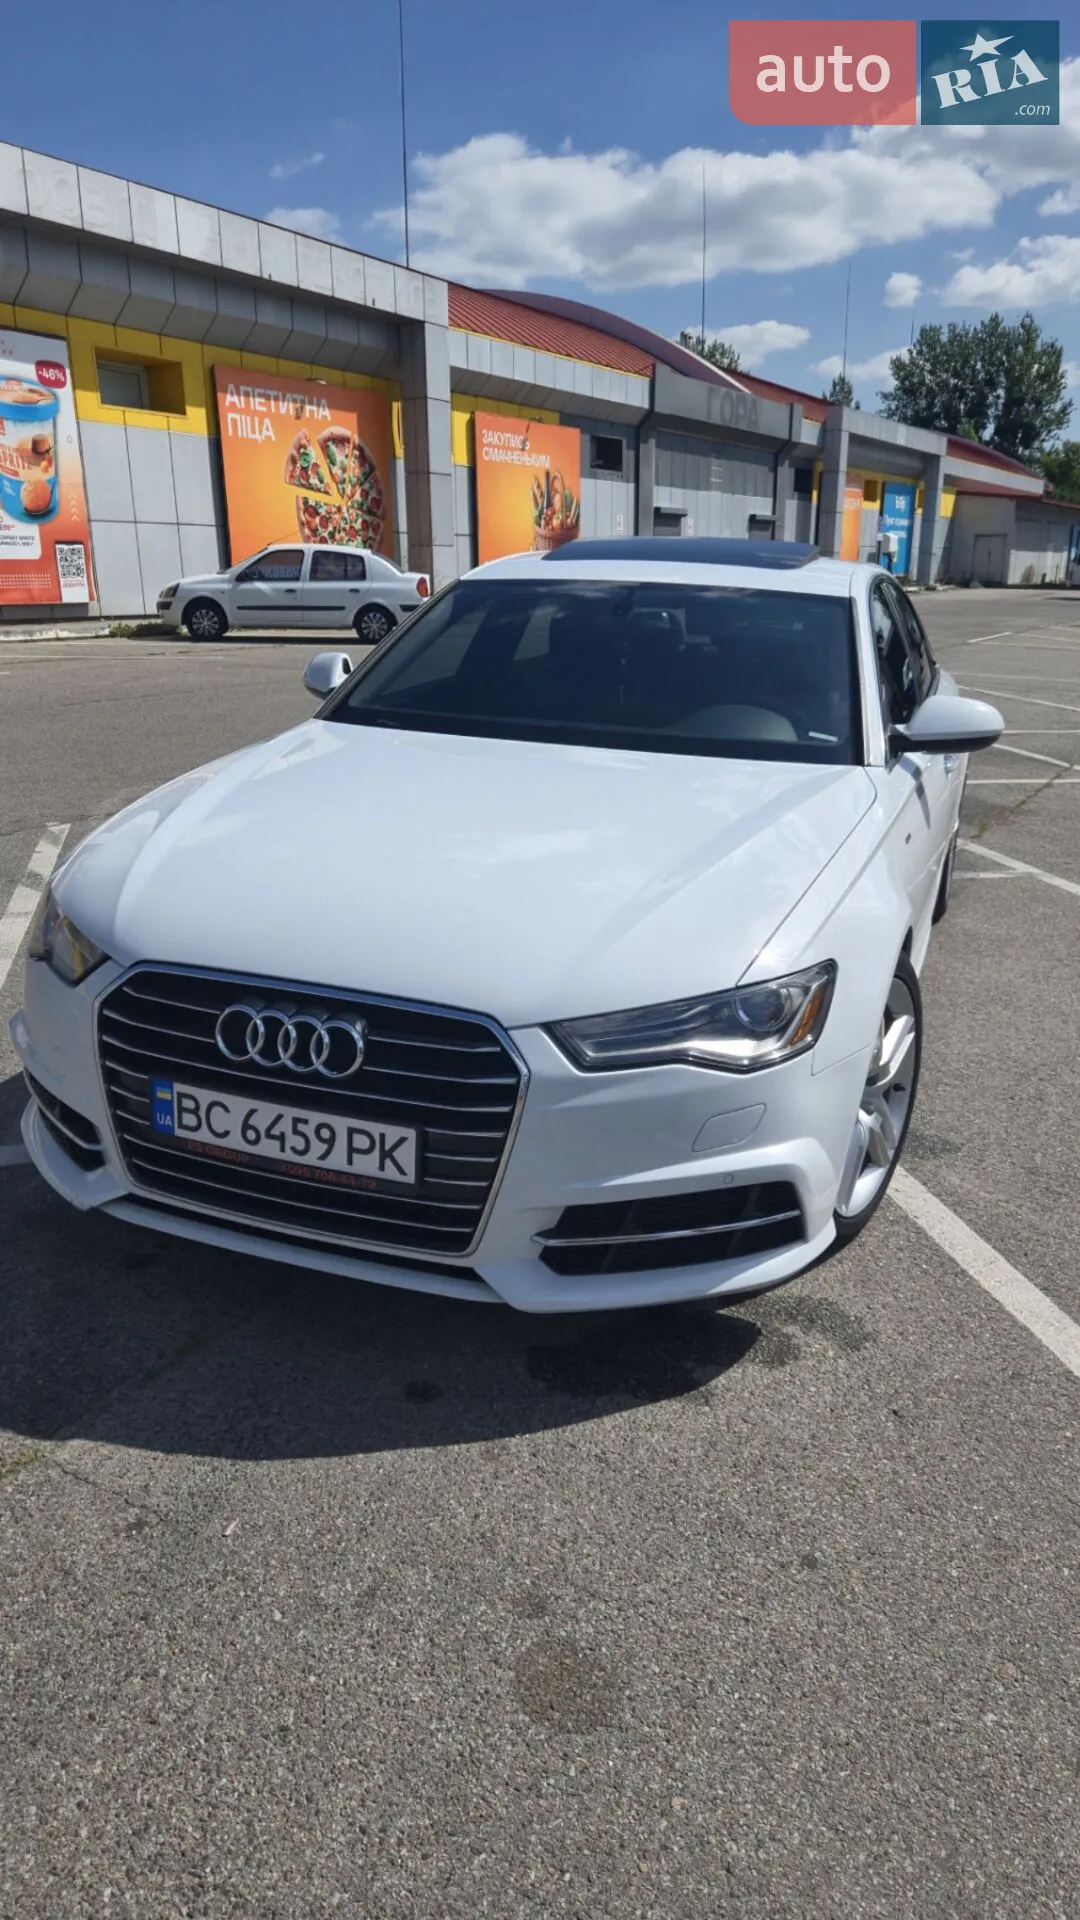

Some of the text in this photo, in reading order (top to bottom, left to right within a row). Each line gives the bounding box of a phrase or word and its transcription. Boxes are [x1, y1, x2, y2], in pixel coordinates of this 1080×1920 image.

[38, 367, 64, 382] -46%
[225, 384, 331, 421] АПЕТИТНА
[227, 412, 276, 443] ПІЦА
[482, 446, 551, 469] СМАЧНЕНЬКИМ
[156, 1112, 172, 1127] UA
[176, 1091, 408, 1177] BC 6459 PK
